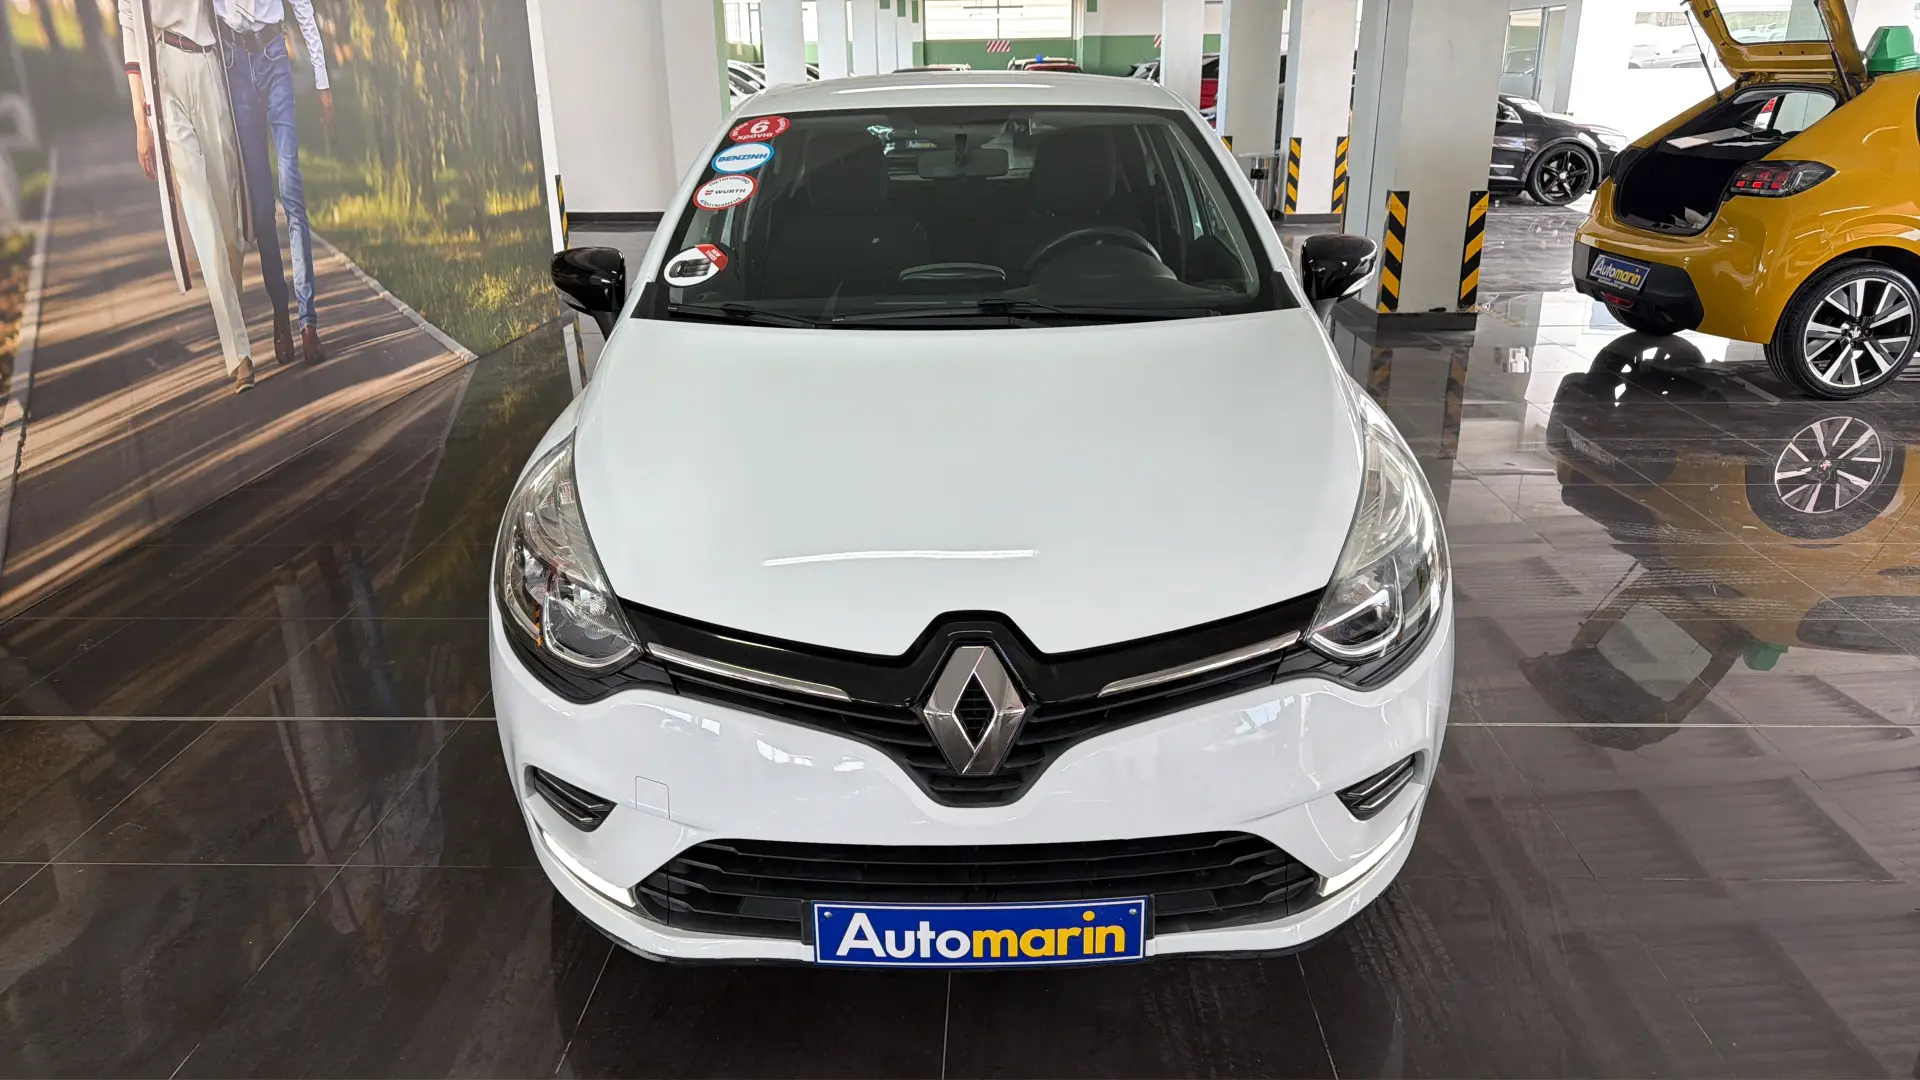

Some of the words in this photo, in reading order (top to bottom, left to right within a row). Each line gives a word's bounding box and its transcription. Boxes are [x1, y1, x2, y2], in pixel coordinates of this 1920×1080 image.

[749, 121, 771, 134] 6
[1594, 258, 1642, 286] Automarin
[835, 910, 1126, 960] Automarin
